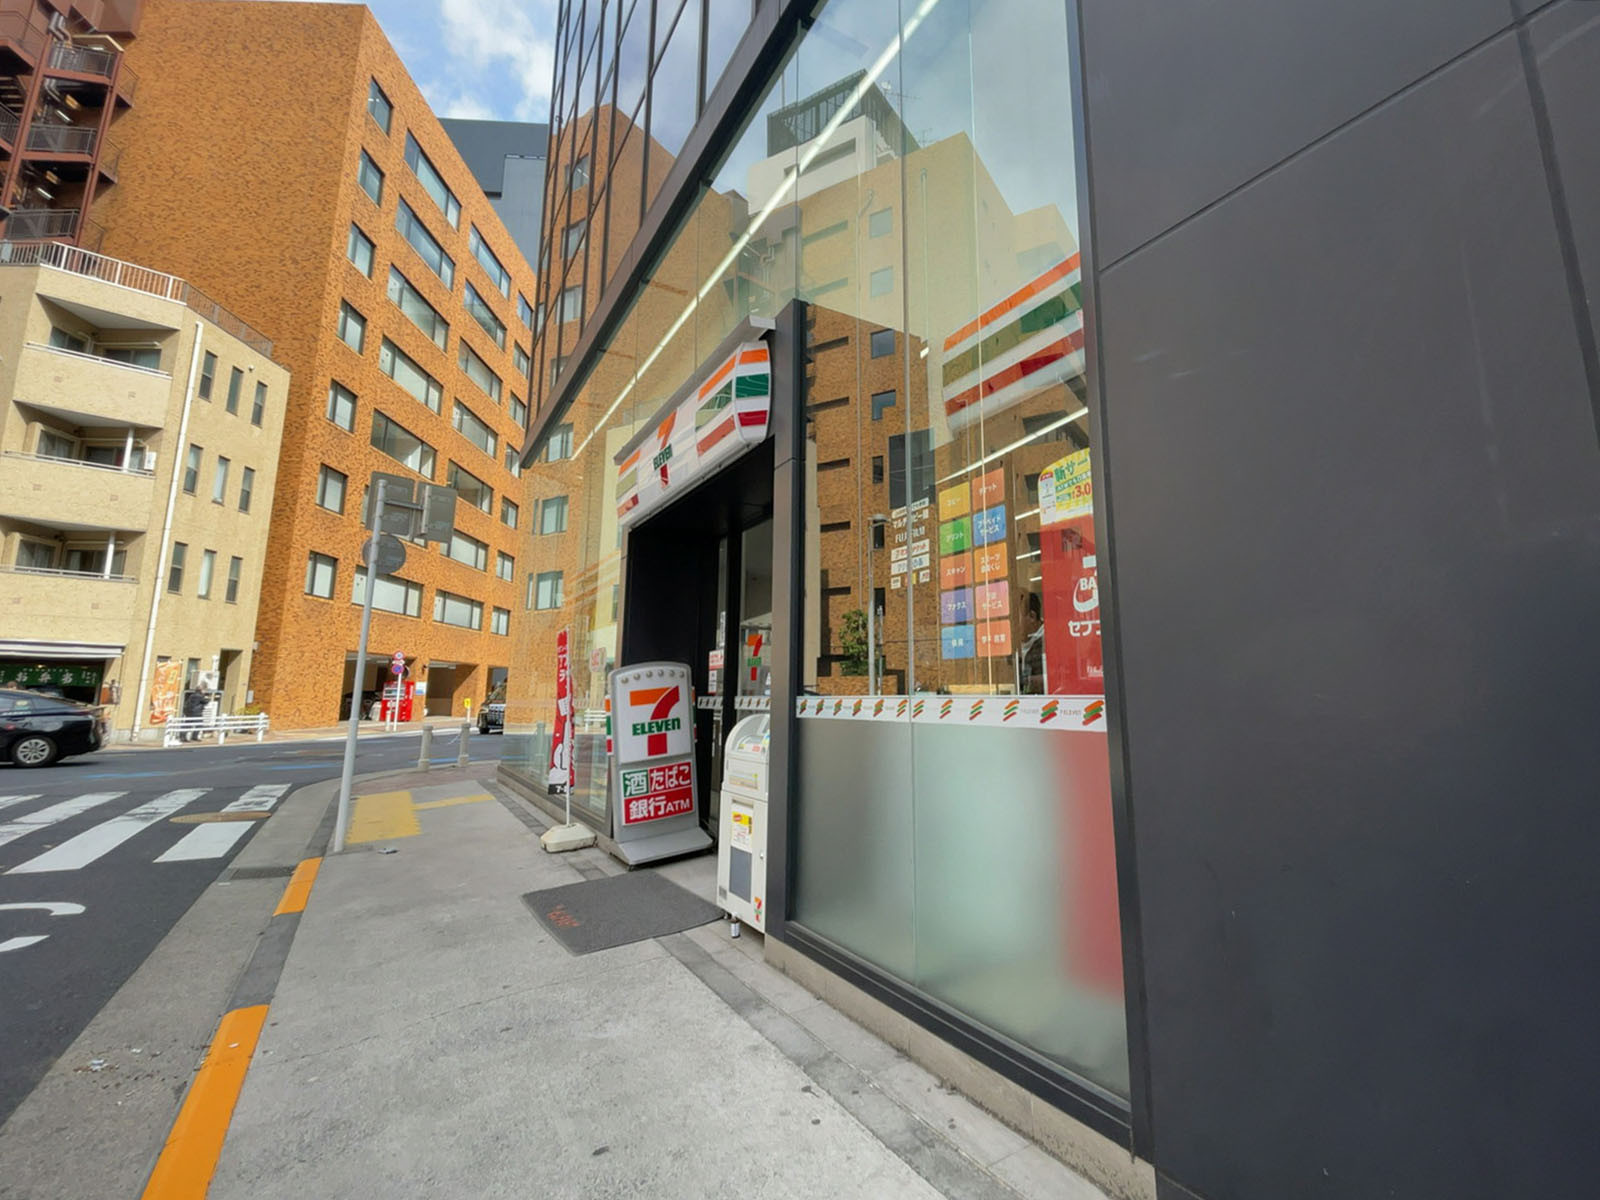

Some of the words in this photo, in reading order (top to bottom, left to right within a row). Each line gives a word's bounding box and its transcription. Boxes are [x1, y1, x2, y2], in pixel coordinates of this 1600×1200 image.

[652, 443, 674, 471] ELEVEN
[629, 685, 680, 756] 7
[631, 717, 681, 736] ELEVEN
[624, 770, 647, 796] 酒
[650, 765, 691, 792] たばこ
